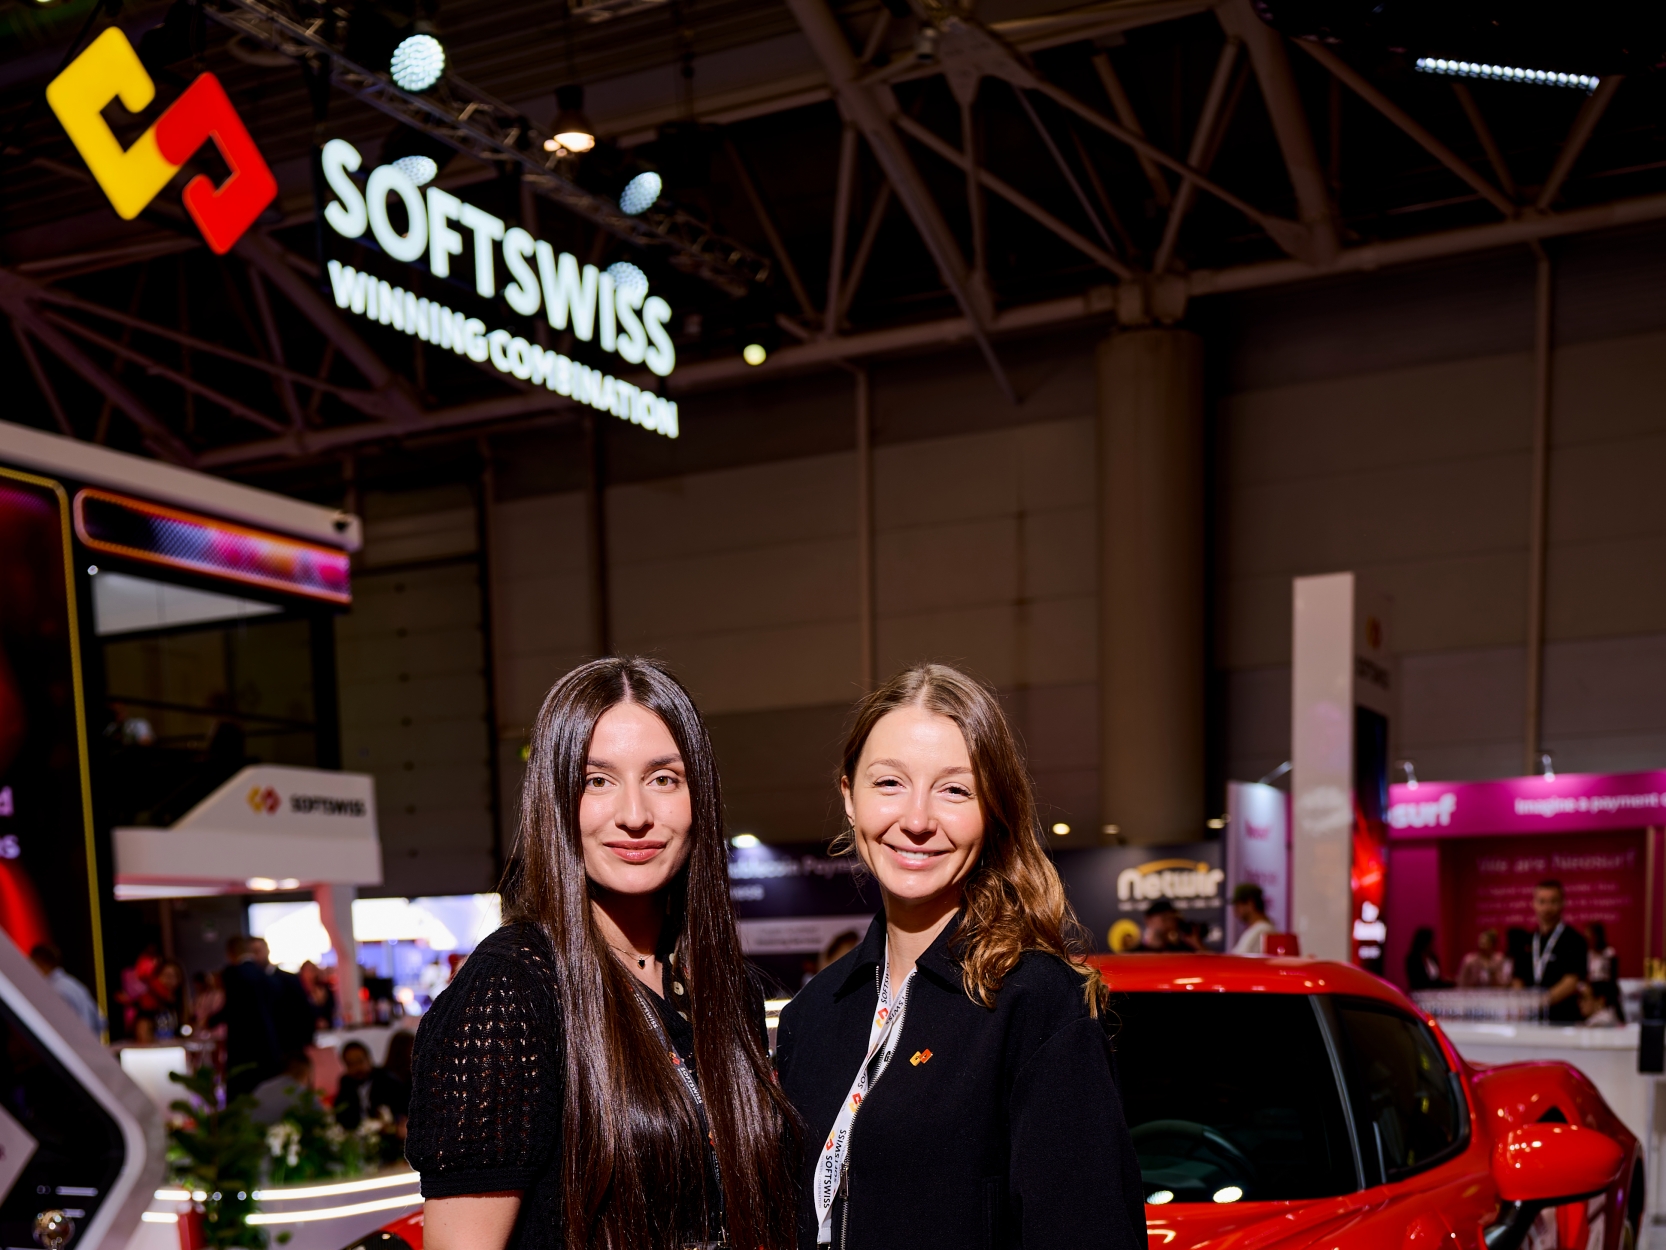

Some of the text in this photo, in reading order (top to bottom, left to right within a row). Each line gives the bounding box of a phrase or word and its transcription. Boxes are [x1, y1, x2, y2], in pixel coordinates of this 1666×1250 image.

[322, 139, 676, 377] SOFTSWISS
[327, 260, 680, 439] WINNING COMBINATION
[1387, 792, 1457, 829] surf
[680, 1067, 703, 1104] SOFTSWISS
[823, 1155, 833, 1209] SOFTSWISS
